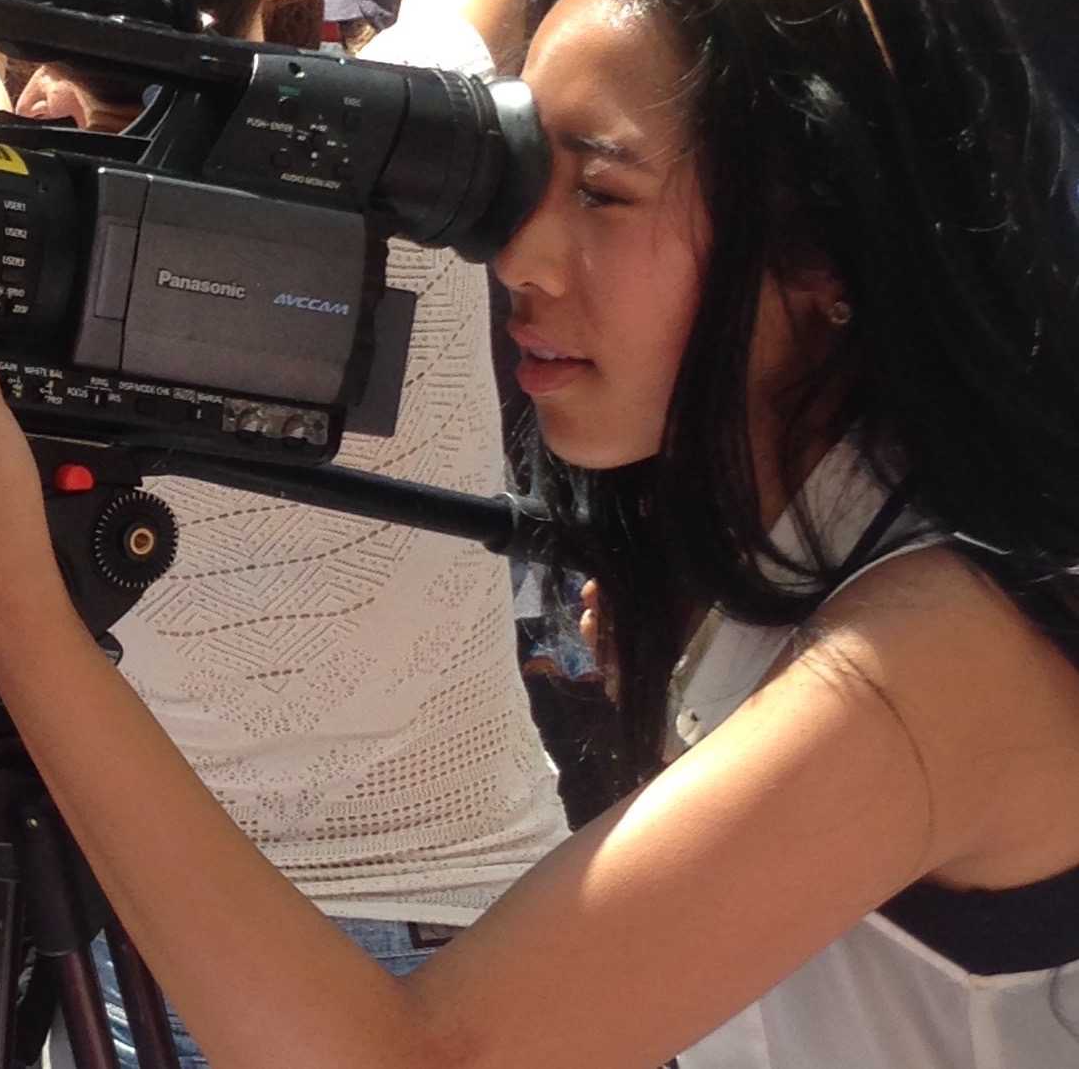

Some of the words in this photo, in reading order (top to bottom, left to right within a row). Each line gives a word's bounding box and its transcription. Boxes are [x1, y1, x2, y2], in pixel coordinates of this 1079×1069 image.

[3, 200, 26, 212] USER1
[158, 270, 247, 299] Panasonic
[273, 293, 351, 316] AVCCAM
